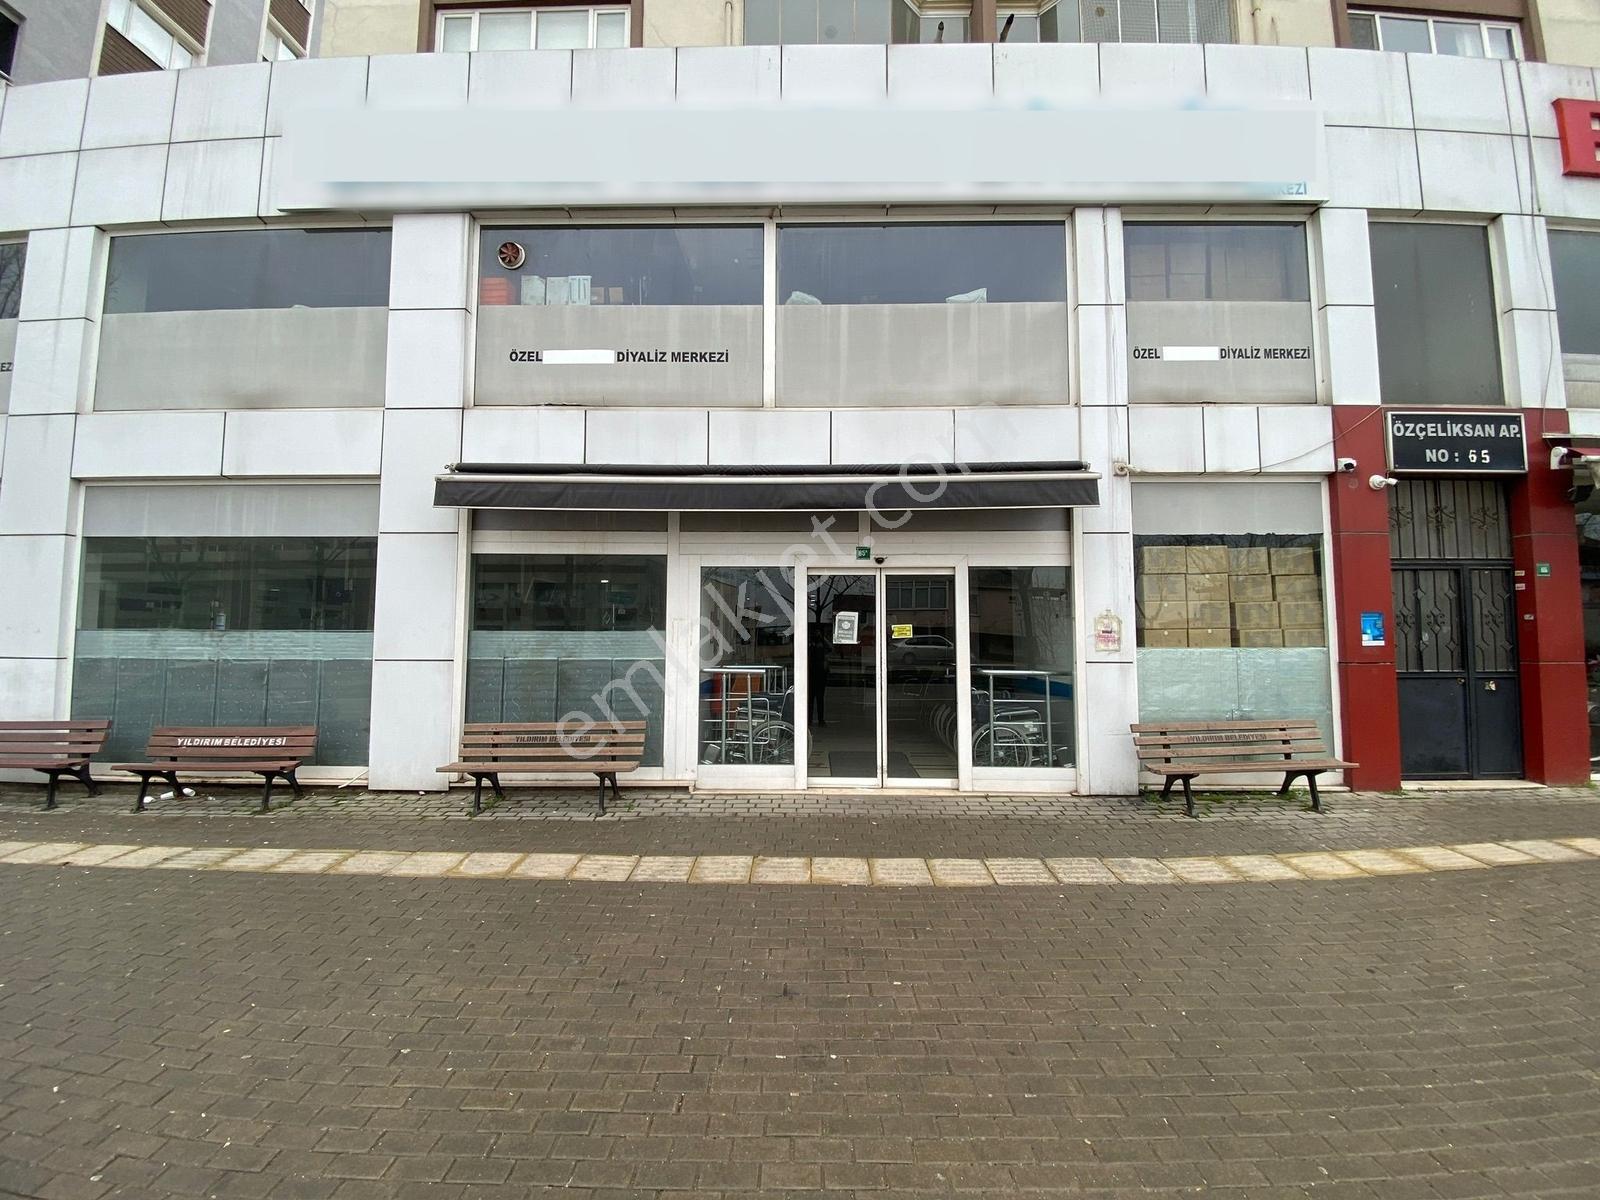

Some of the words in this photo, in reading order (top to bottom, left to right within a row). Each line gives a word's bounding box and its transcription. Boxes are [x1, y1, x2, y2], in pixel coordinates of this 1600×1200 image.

[509, 348, 543, 362] ÖZEL
[616, 348, 667, 363] DİYALİZ
[670, 348, 729, 363] MERKEZİ
[1133, 346, 1161, 359] ÖZEL
[1220, 345, 1261, 360] DİYALİZ
[1263, 345, 1311, 360] MERKEZİ
[1393, 420, 1495, 440] ÖZÇELİKSAN
[1499, 423, 1521, 438] AP.
[177, 738, 222, 747] YILDIRIM
